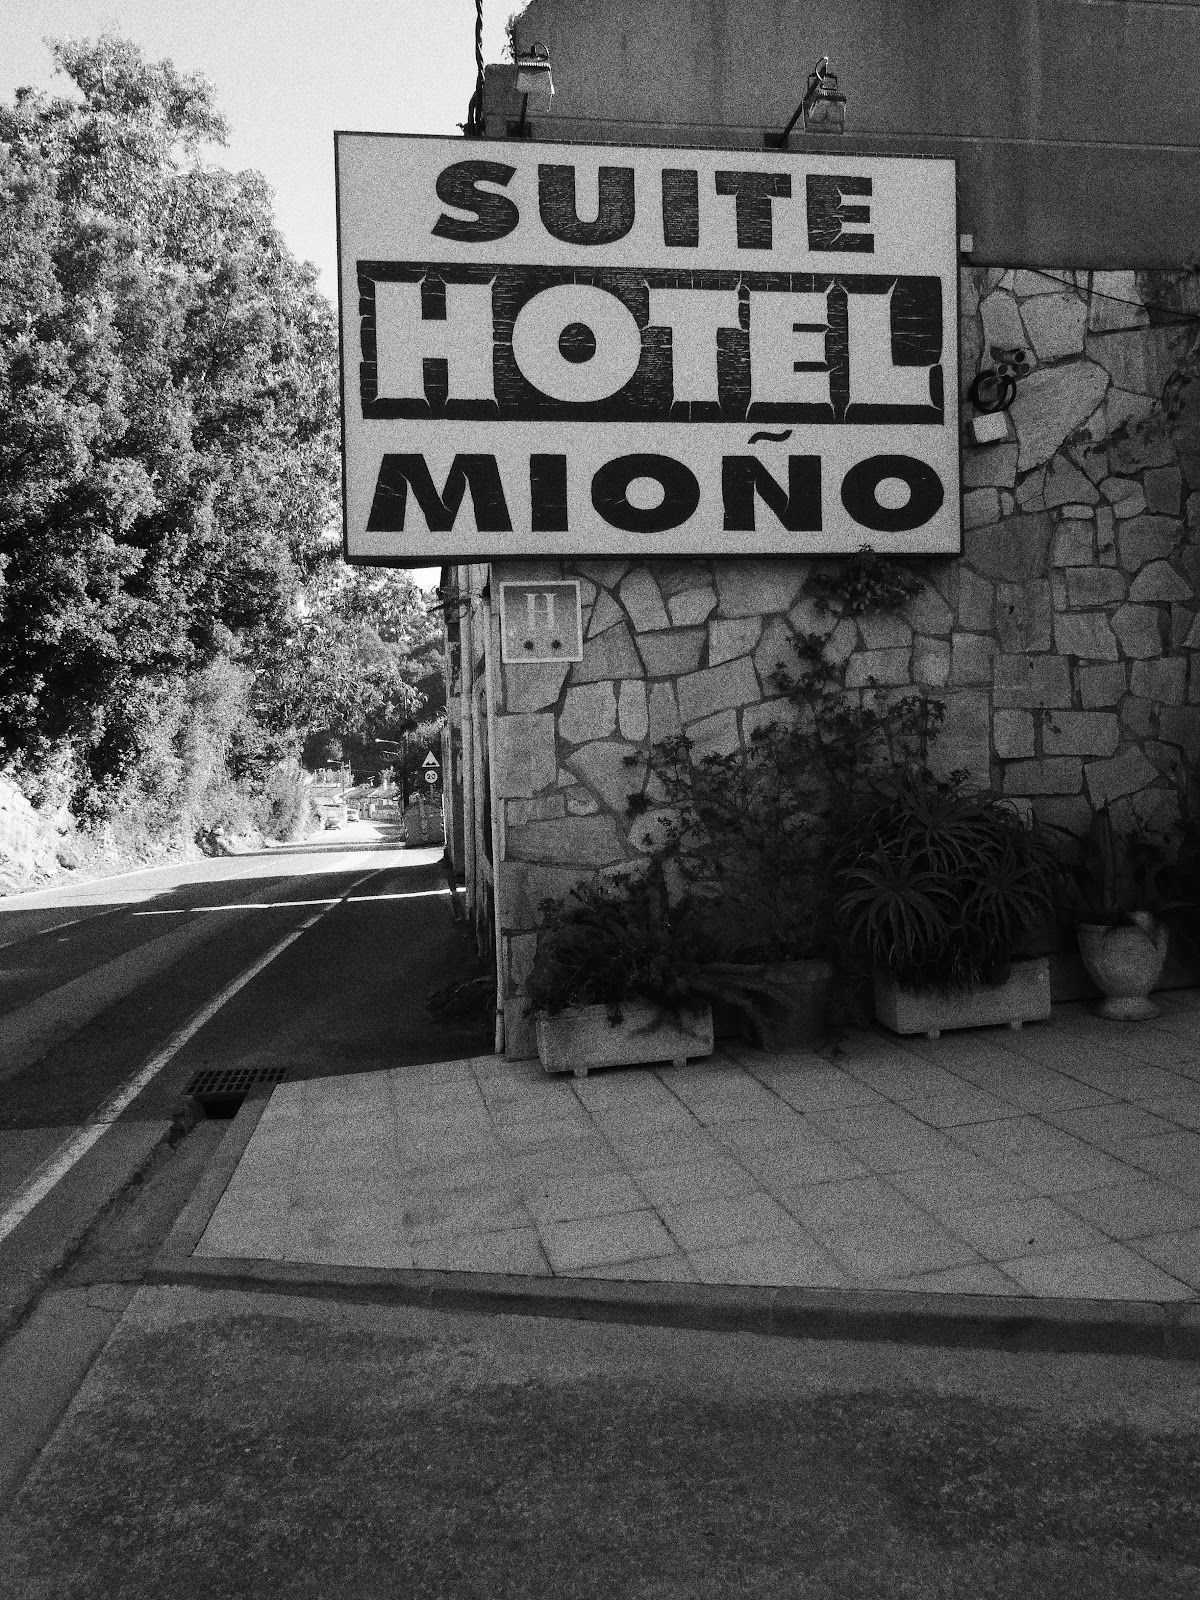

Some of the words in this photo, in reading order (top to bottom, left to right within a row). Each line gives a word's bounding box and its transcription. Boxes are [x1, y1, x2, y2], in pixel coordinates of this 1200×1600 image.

[431, 160, 875, 253] SUITE
[373, 279, 939, 408] HOTEL
[366, 430, 944, 533] MIOÑO
